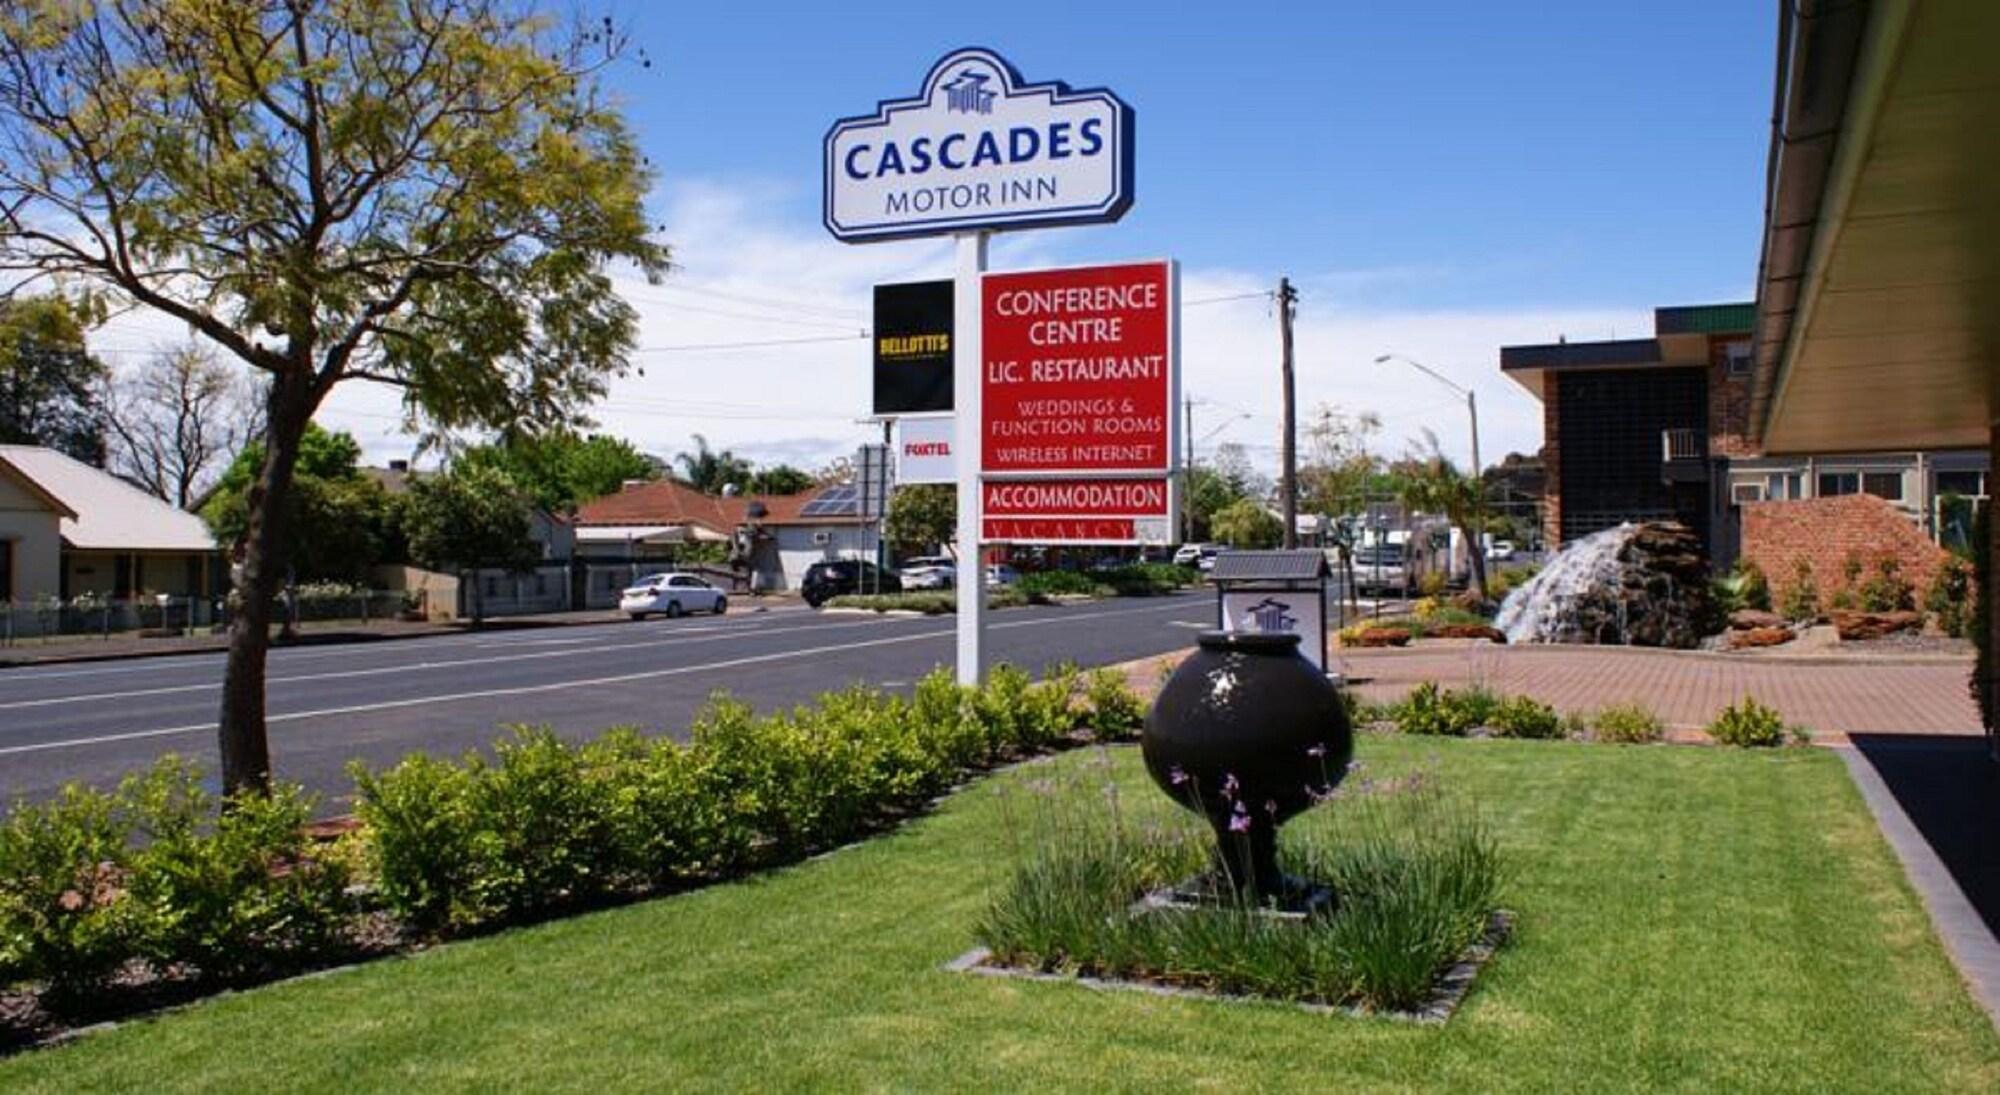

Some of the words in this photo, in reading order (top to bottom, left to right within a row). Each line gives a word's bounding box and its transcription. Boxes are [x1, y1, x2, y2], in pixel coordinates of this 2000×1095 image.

[844, 118, 1104, 180] CASCADES
[885, 183, 991, 215] MOTOR
[1001, 176, 1057, 205] INN
[996, 283, 1158, 316] CONFERENCE
[1029, 317, 1123, 346] CENTRE
[988, 361, 1024, 384] LIC.
[1031, 355, 1163, 382] RESTAURANT
[1018, 399, 1115, 417] WEDDINGS
[1120, 398, 1134, 414] &
[992, 418, 1086, 436] FUNCTION
[1093, 416, 1162, 434] ROOMS
[905, 442, 951, 457] FOXTEL
[996, 447, 1067, 463] WIRELESS
[1072, 444, 1156, 461] INTERNET
[988, 483, 1163, 509] ACCOMMODATION
[991, 522, 1132, 540] VACANCY
